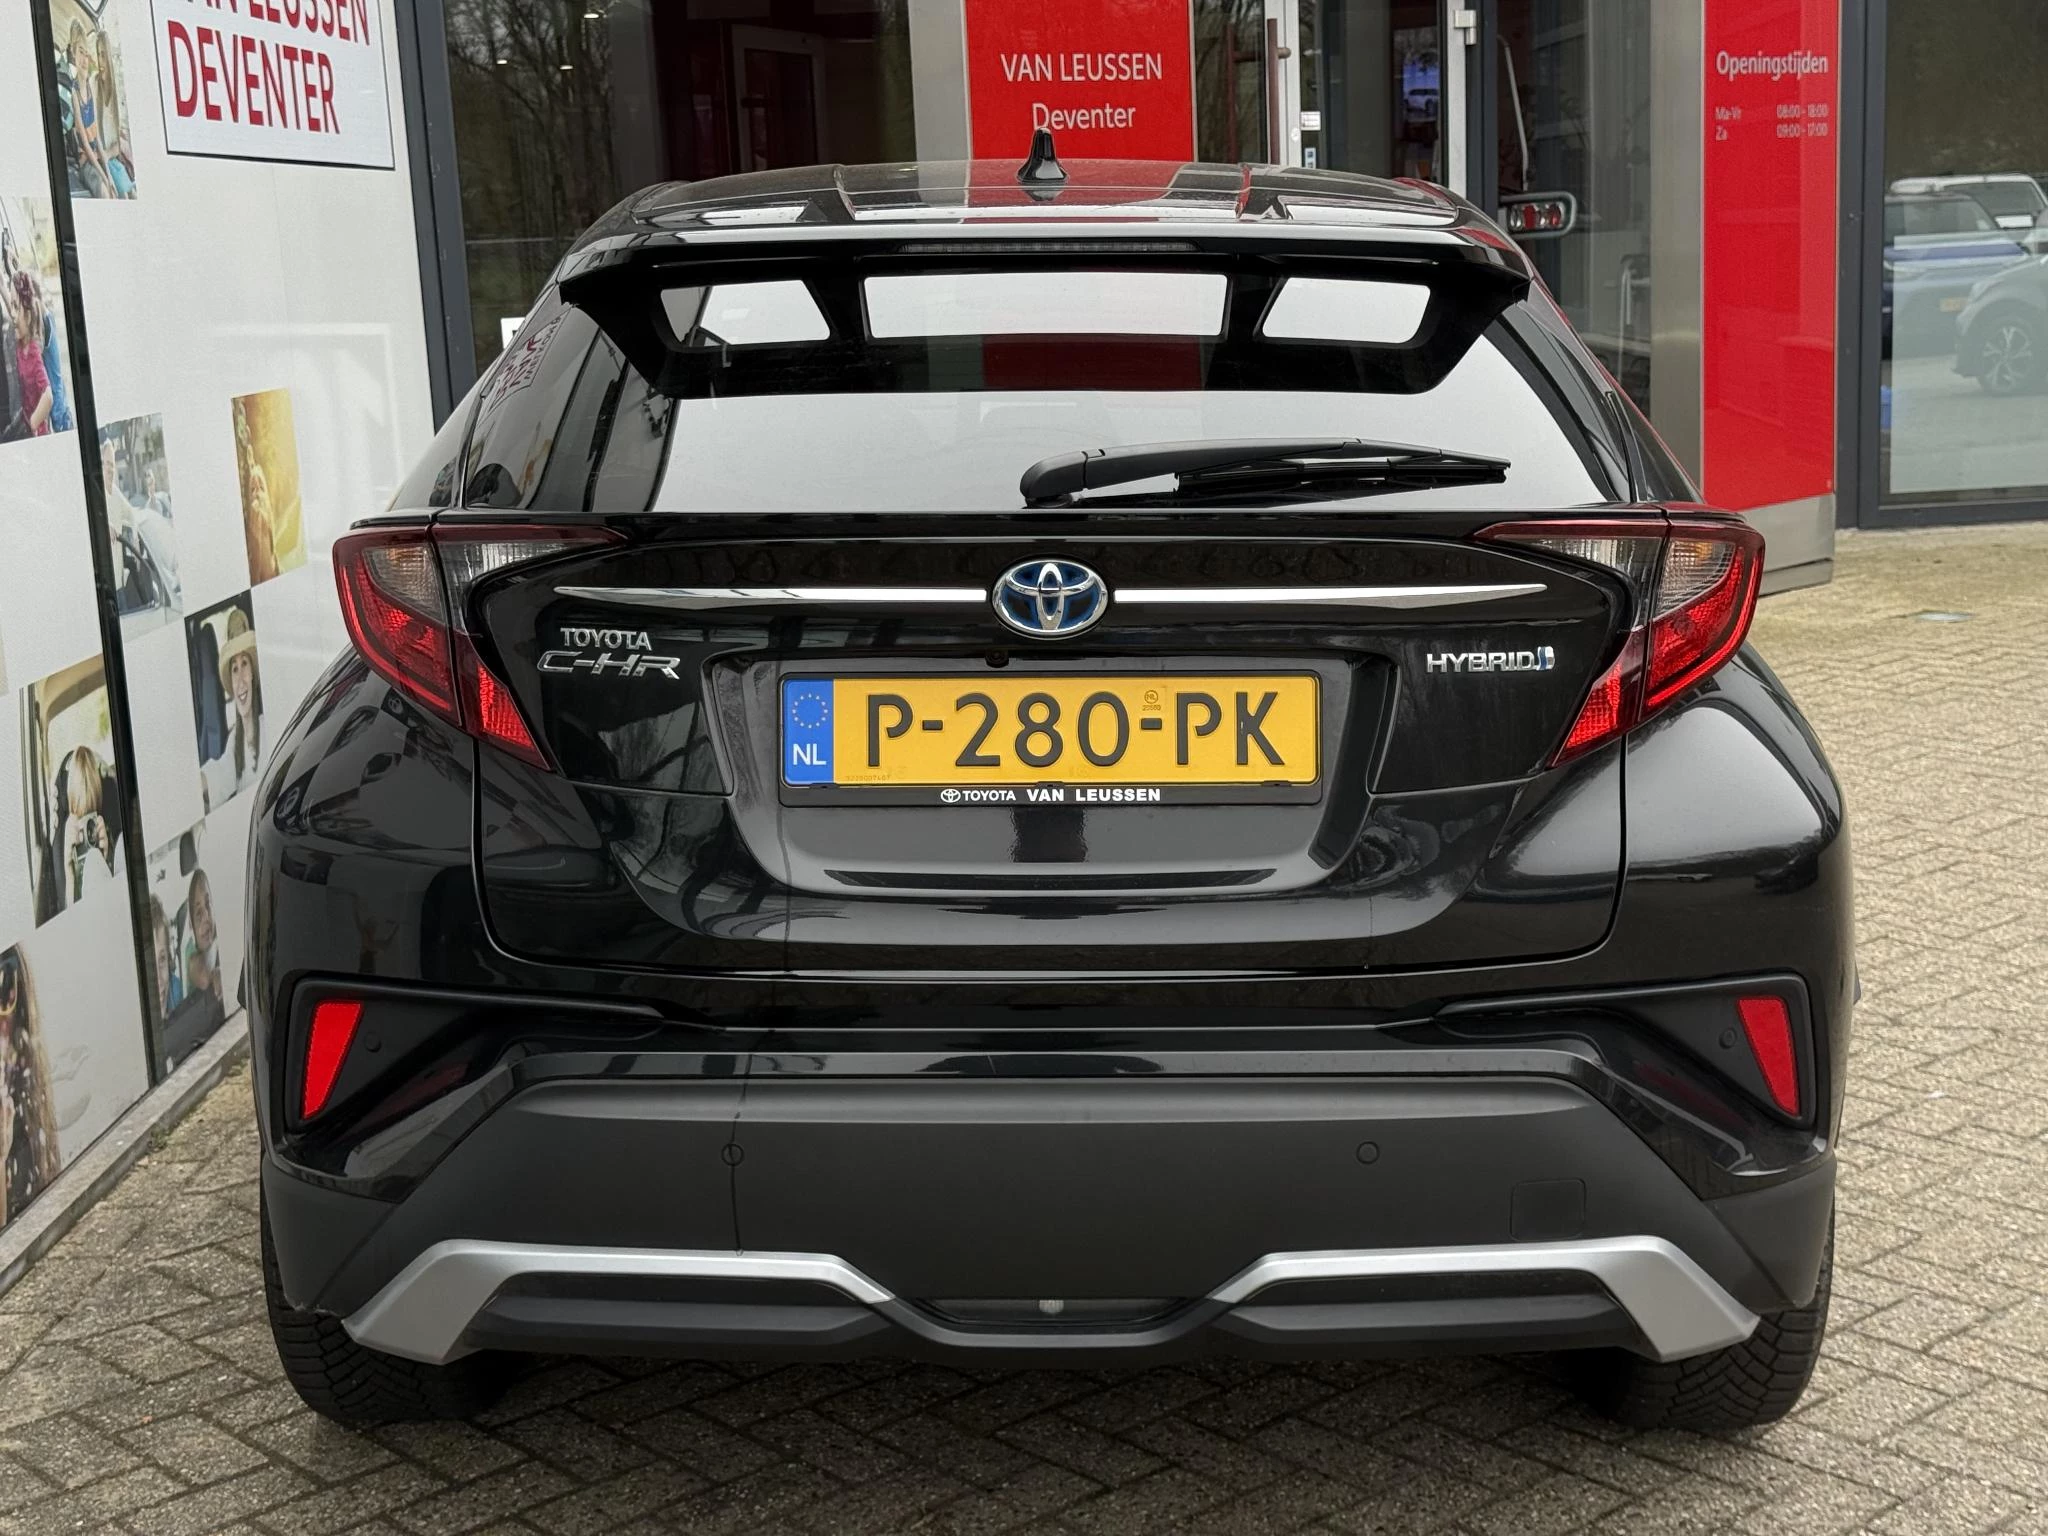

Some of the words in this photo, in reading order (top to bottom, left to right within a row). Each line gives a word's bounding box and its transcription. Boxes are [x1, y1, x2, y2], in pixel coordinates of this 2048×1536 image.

[168, 20, 340, 134] DEVENTER
[1000, 53, 1052, 82] VAN
[1060, 53, 1163, 81] LEUSSEN
[1716, 50, 1829, 82] Openingstijden
[1032, 103, 1136, 130] Deventer
[560, 627, 652, 651] TOYOTA
[537, 650, 681, 680] C-HR
[1426, 651, 1536, 673] HYBRID
[867, 691, 1285, 768] P-280-PK
[792, 743, 827, 766] NL
[962, 790, 1017, 801] TOYOTA
[1026, 789, 1064, 801] VAN
[1075, 788, 1161, 801] LEUSSEN
